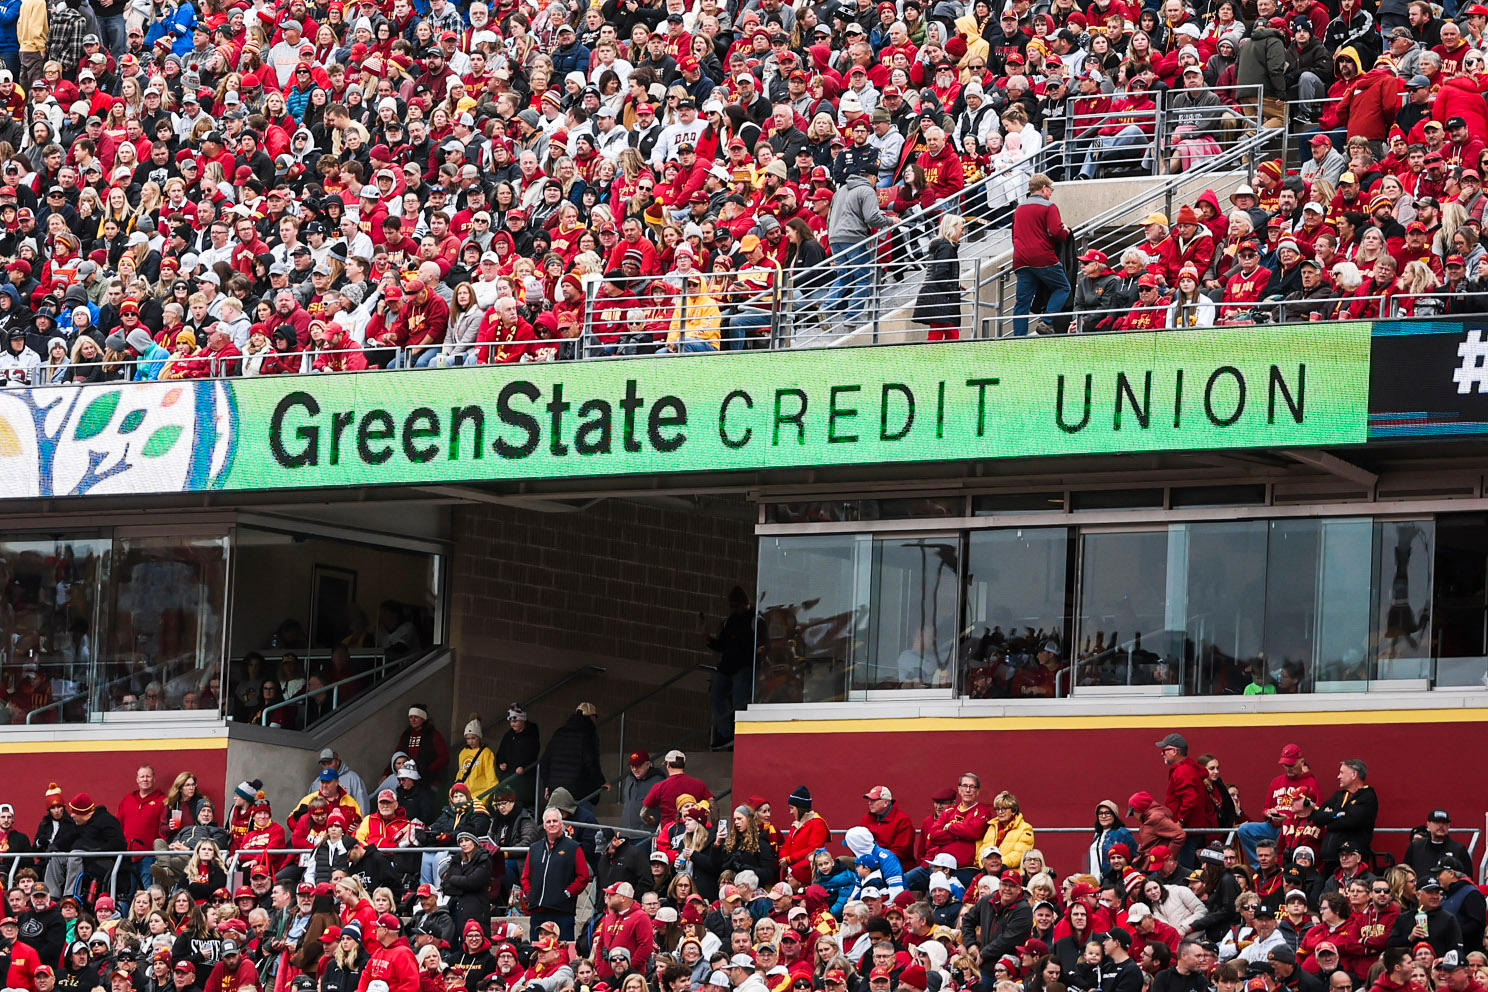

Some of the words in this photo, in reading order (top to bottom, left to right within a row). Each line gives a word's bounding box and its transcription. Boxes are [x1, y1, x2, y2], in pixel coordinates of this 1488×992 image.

[270, 380, 687, 468] GreenState
[719, 379, 999, 449] CREDIT
[1056, 364, 1305, 434] UNION
